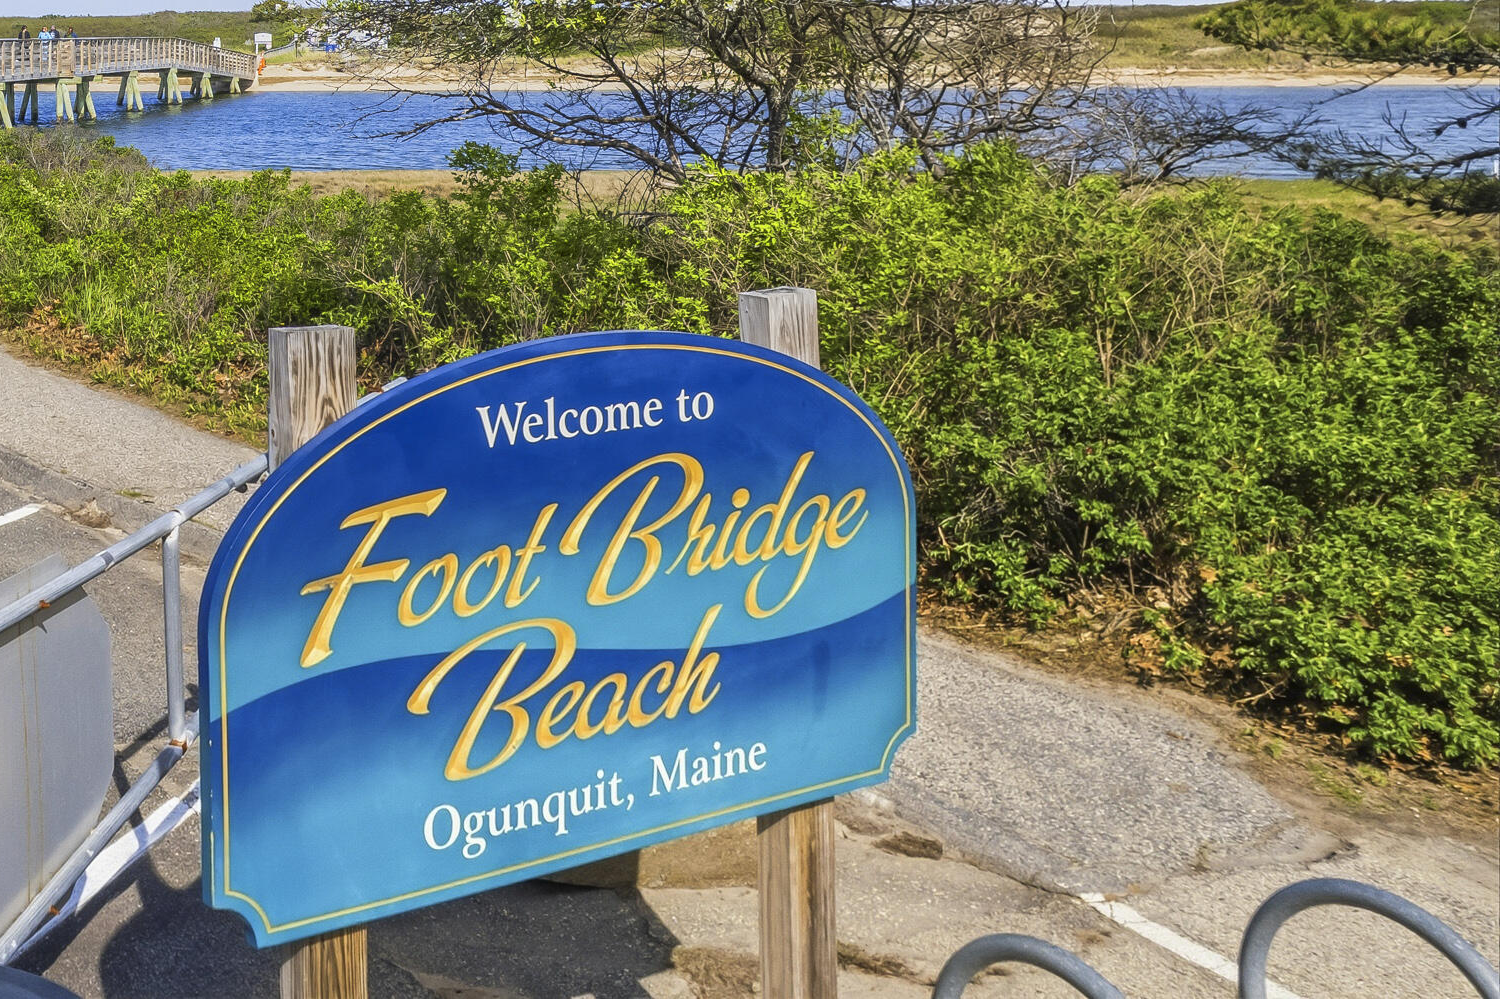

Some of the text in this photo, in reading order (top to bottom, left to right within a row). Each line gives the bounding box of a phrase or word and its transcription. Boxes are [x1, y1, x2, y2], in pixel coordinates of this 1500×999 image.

[476, 389, 714, 448] Welcome to
[299, 451, 867, 668] Foot Bridge
[407, 604, 722, 781] Beach
[423, 741, 767, 859] Ogunquit, Maine
